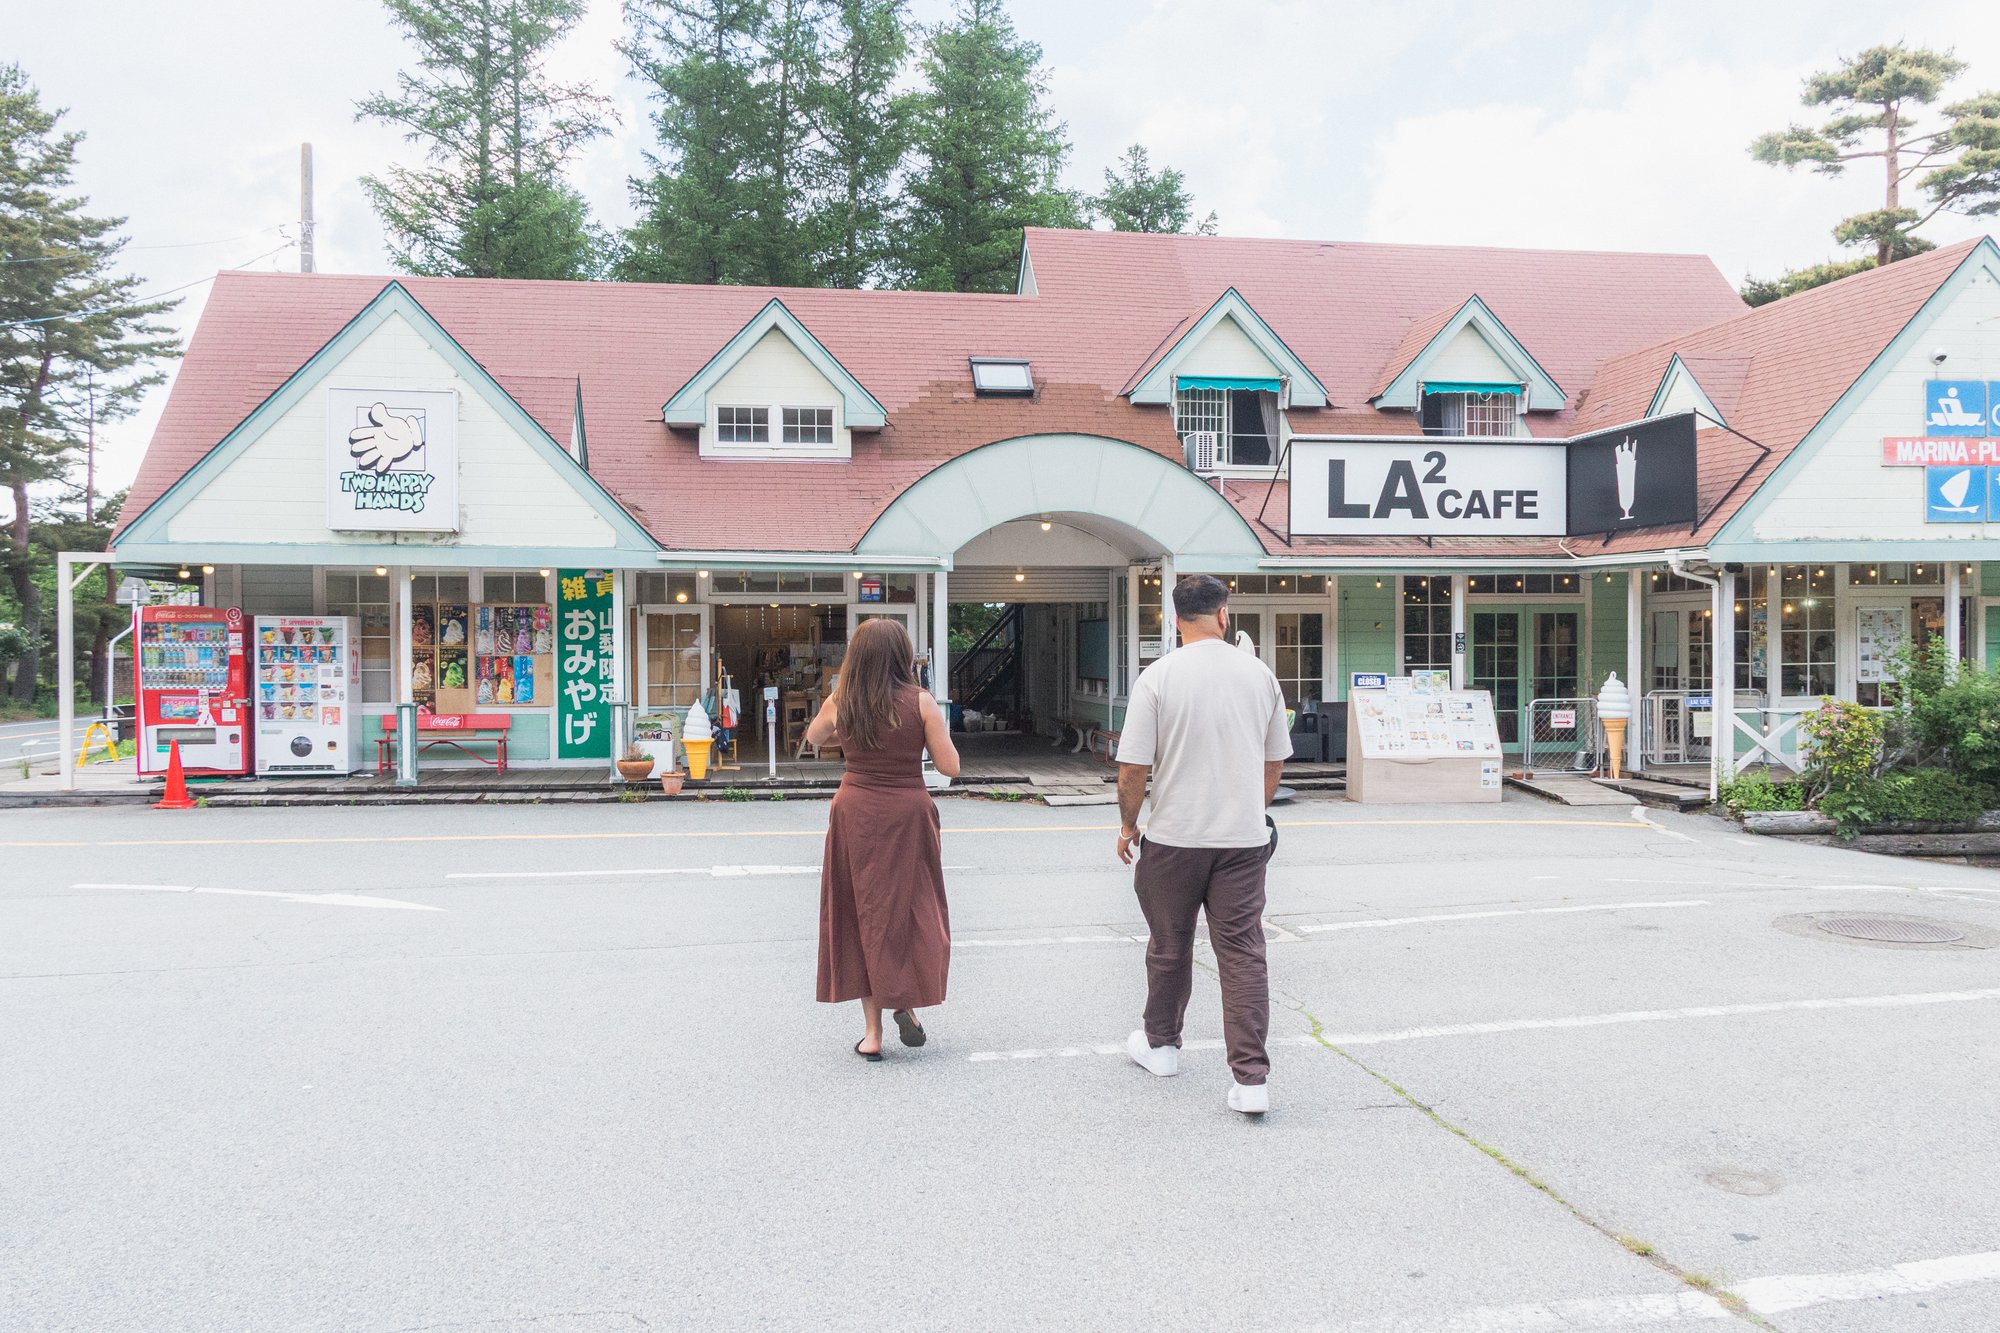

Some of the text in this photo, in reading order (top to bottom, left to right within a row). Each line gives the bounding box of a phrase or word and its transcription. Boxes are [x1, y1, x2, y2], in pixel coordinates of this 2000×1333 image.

[340, 471, 435, 494] TWO HAPPY
[355, 491, 424, 514] HANDS
[1436, 489, 1538, 520] CAFE
[563, 609, 597, 745] おみやげ
[1358, 678, 1381, 686] CLOSED
[432, 716, 461, 727] Coca-Cola
